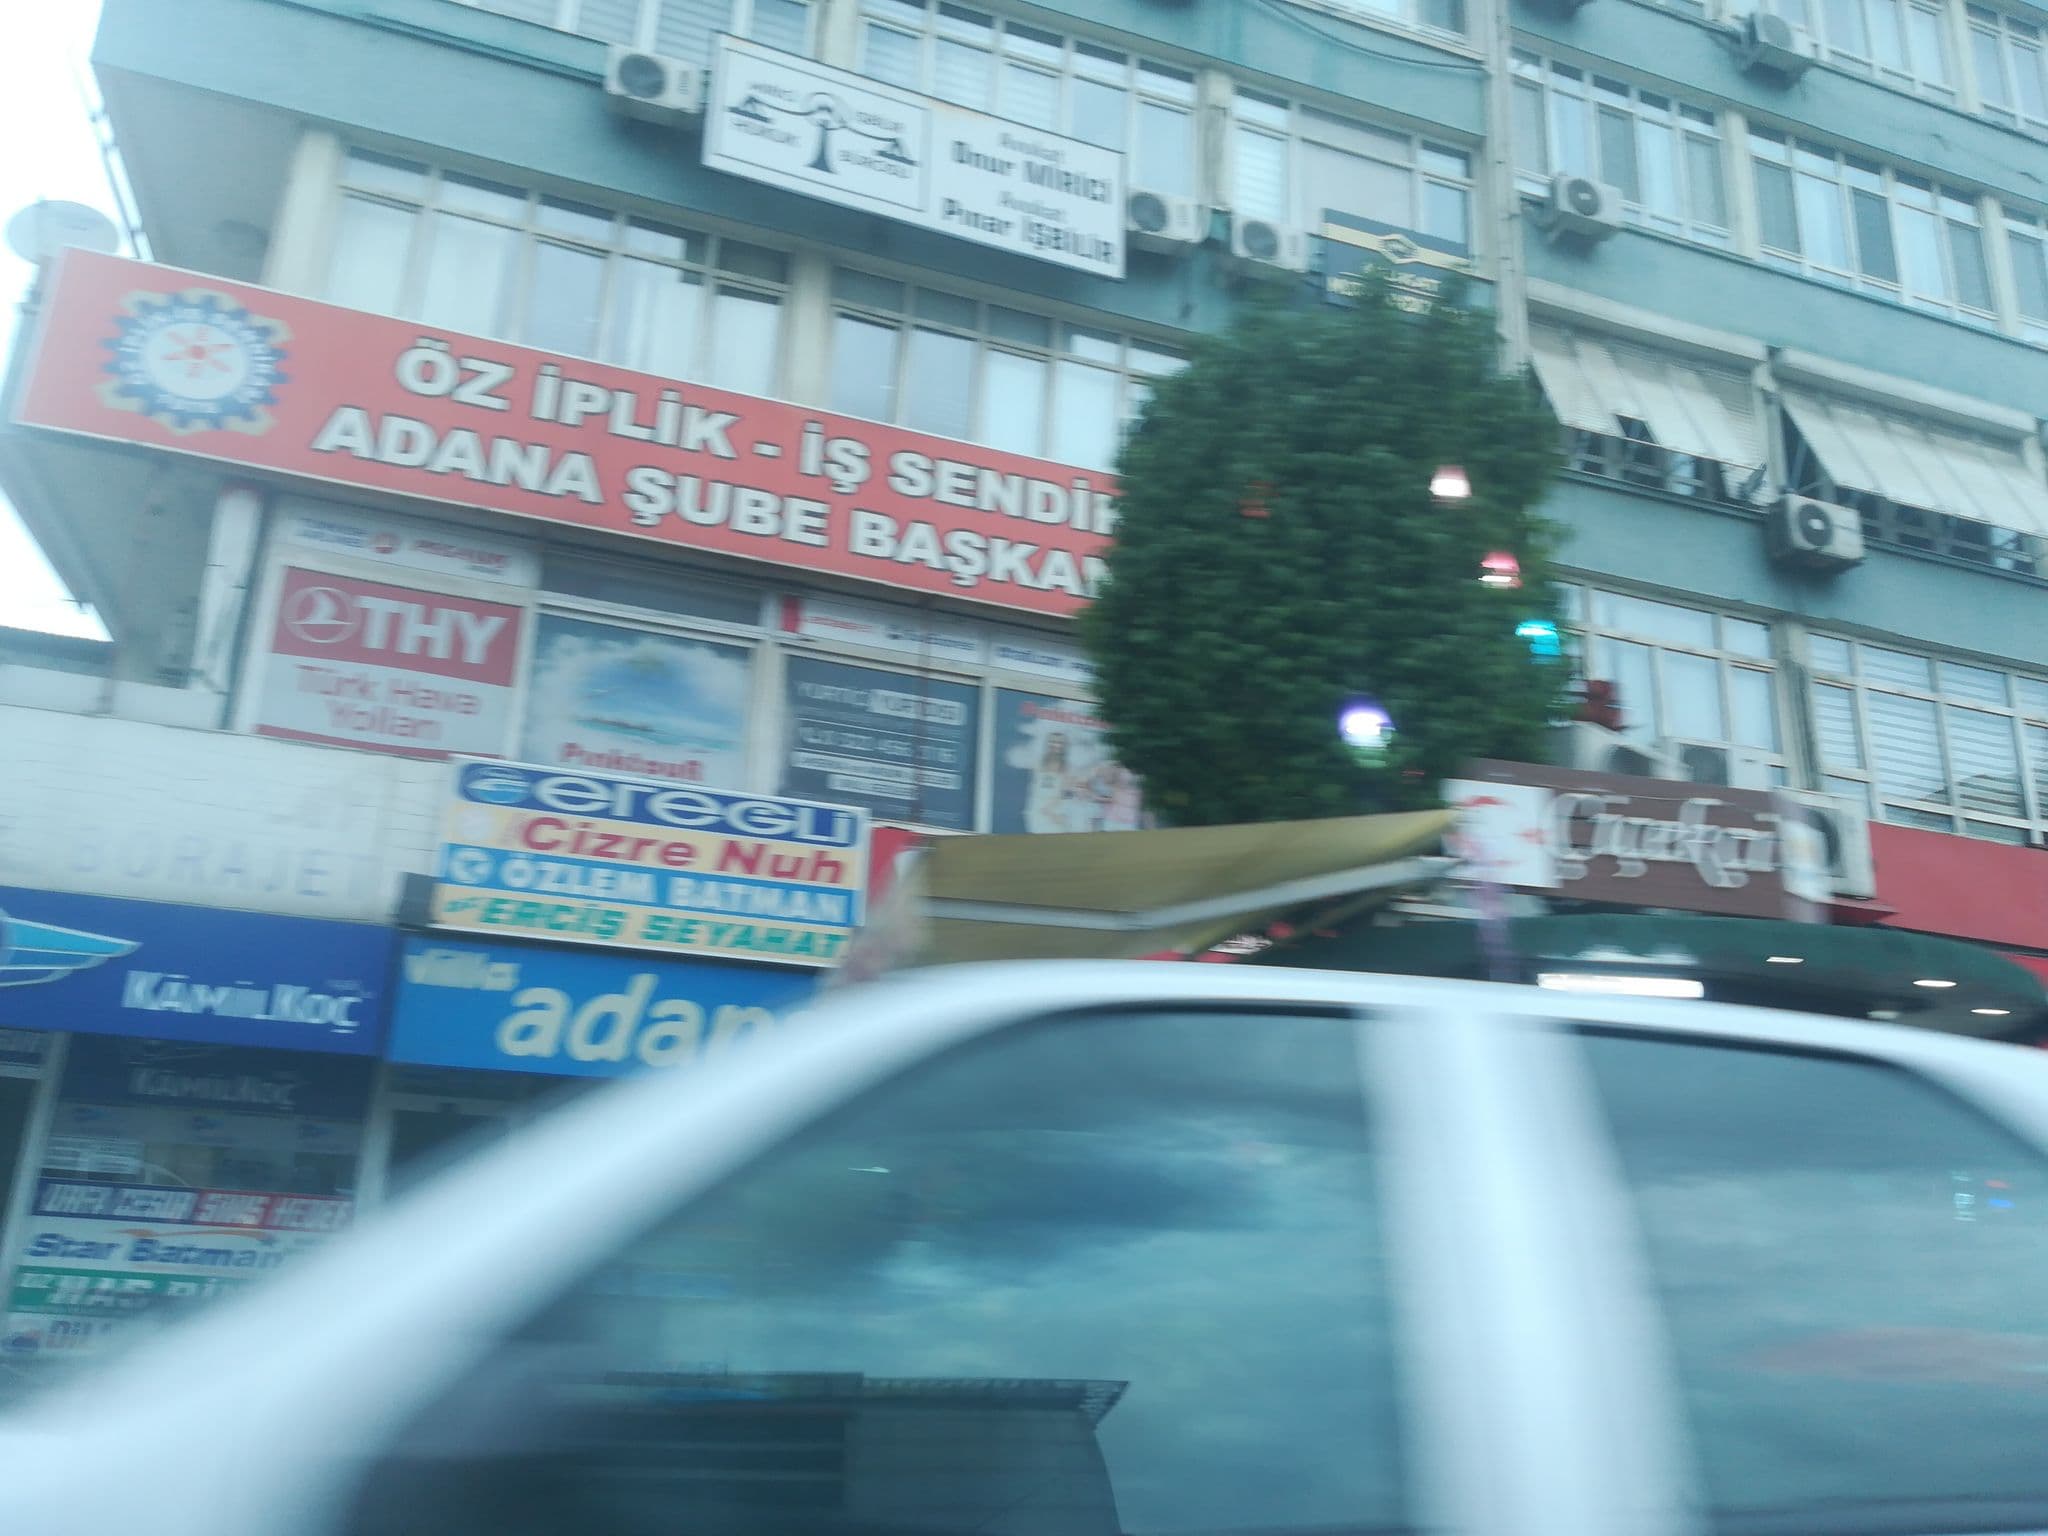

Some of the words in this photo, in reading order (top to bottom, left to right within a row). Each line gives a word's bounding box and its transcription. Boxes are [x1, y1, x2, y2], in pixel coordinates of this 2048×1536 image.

[952, 139, 1014, 176] Onur
[396, 338, 515, 410] ÖZ
[531, 364, 739, 459] İPLİK
[800, 421, 872, 494] İŞ
[311, 405, 604, 505] ADANA
[622, 466, 832, 547] ŞUBE
[356, 595, 508, 665] THY
[388, 678, 481, 716] Hava
[521, 816, 698, 867] Cizre
[715, 838, 844, 885] Nuh
[501, 854, 657, 903] ÖZLEM
[668, 876, 850, 923] BATMAN
[29, 1232, 120, 1260] Star
